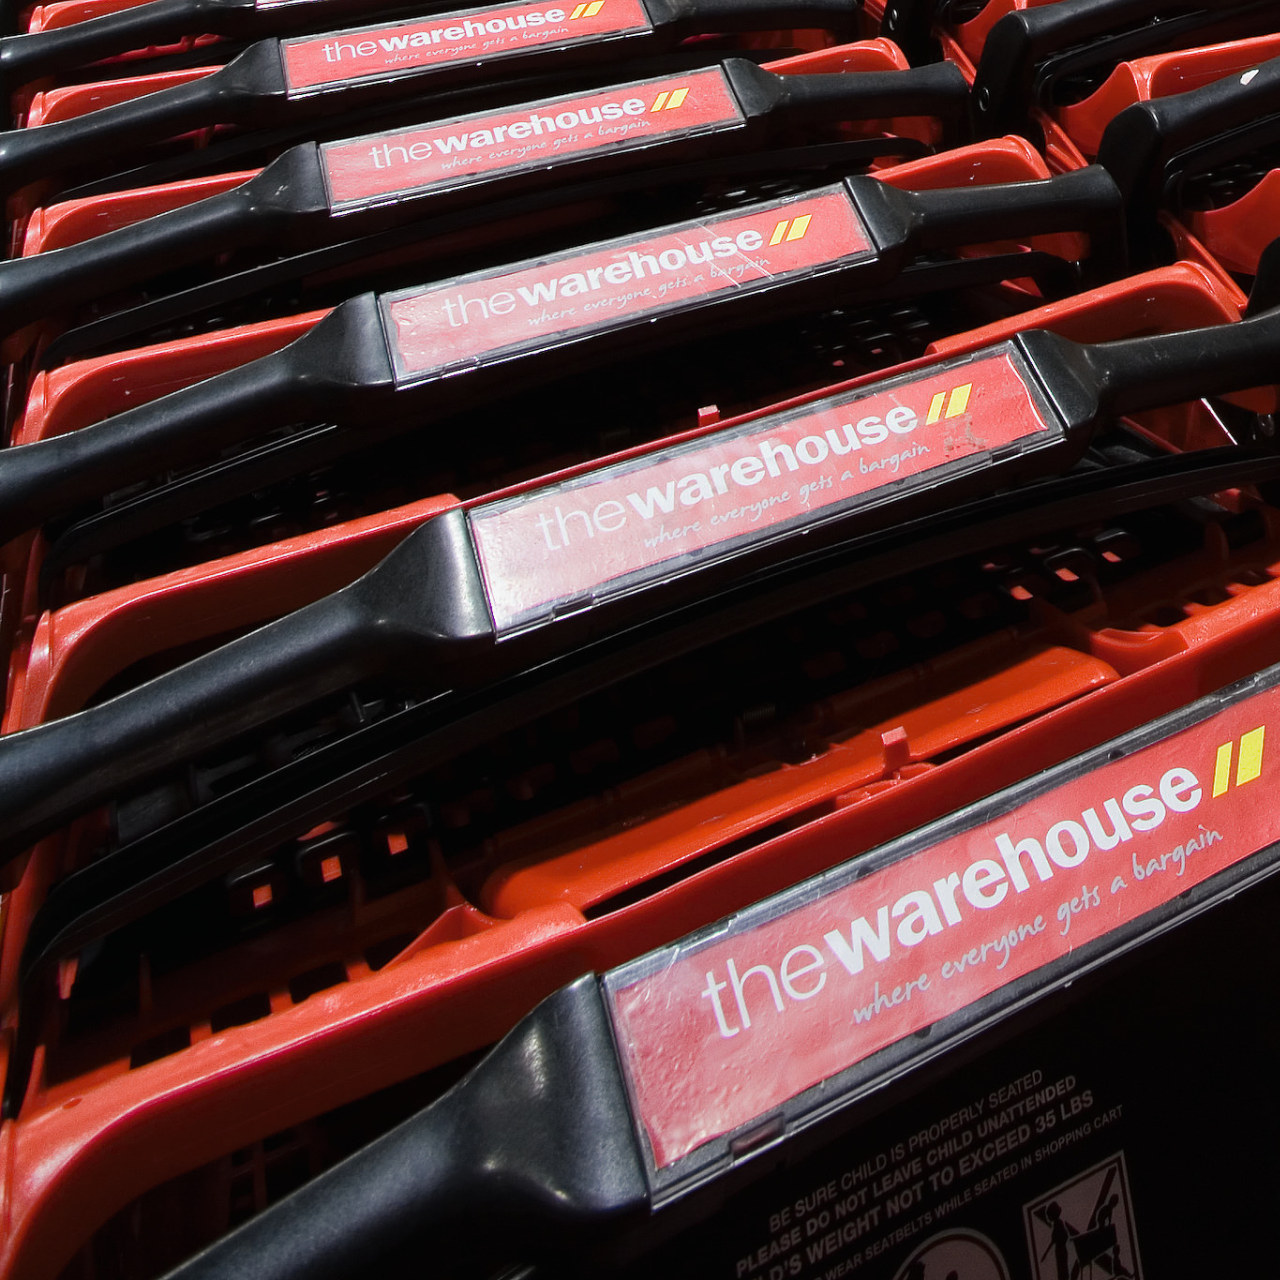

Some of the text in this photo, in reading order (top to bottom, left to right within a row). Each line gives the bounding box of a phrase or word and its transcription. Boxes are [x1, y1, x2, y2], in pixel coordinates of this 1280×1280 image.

[852, 825, 1224, 1027] where everyone gets a bargain
[735, 1230, 803, 1278] PLEASE
[805, 1213, 831, 1238] DO
[834, 1191, 869, 1224] NOT
[872, 1161, 924, 1204] LEAVE
[926, 1132, 974, 1176] CHILD
[976, 1074, 1078, 1144] UNATTENDED
[769, 1068, 1044, 1232] BE SURE CHILD IS PROPERLY SEATED
[805, 1089, 1096, 1263] WEIGHT NOT TO EXCEED 35 LBS
[866, 1211, 934, 1262] SEATBELTS
[934, 1188, 973, 1219] WHILE
[975, 1165, 1020, 1197] SEATED
[1021, 1157, 1033, 1173] IN
[1035, 1123, 1092, 1161] SHOPPING
[1094, 1103, 1125, 1133] CART
